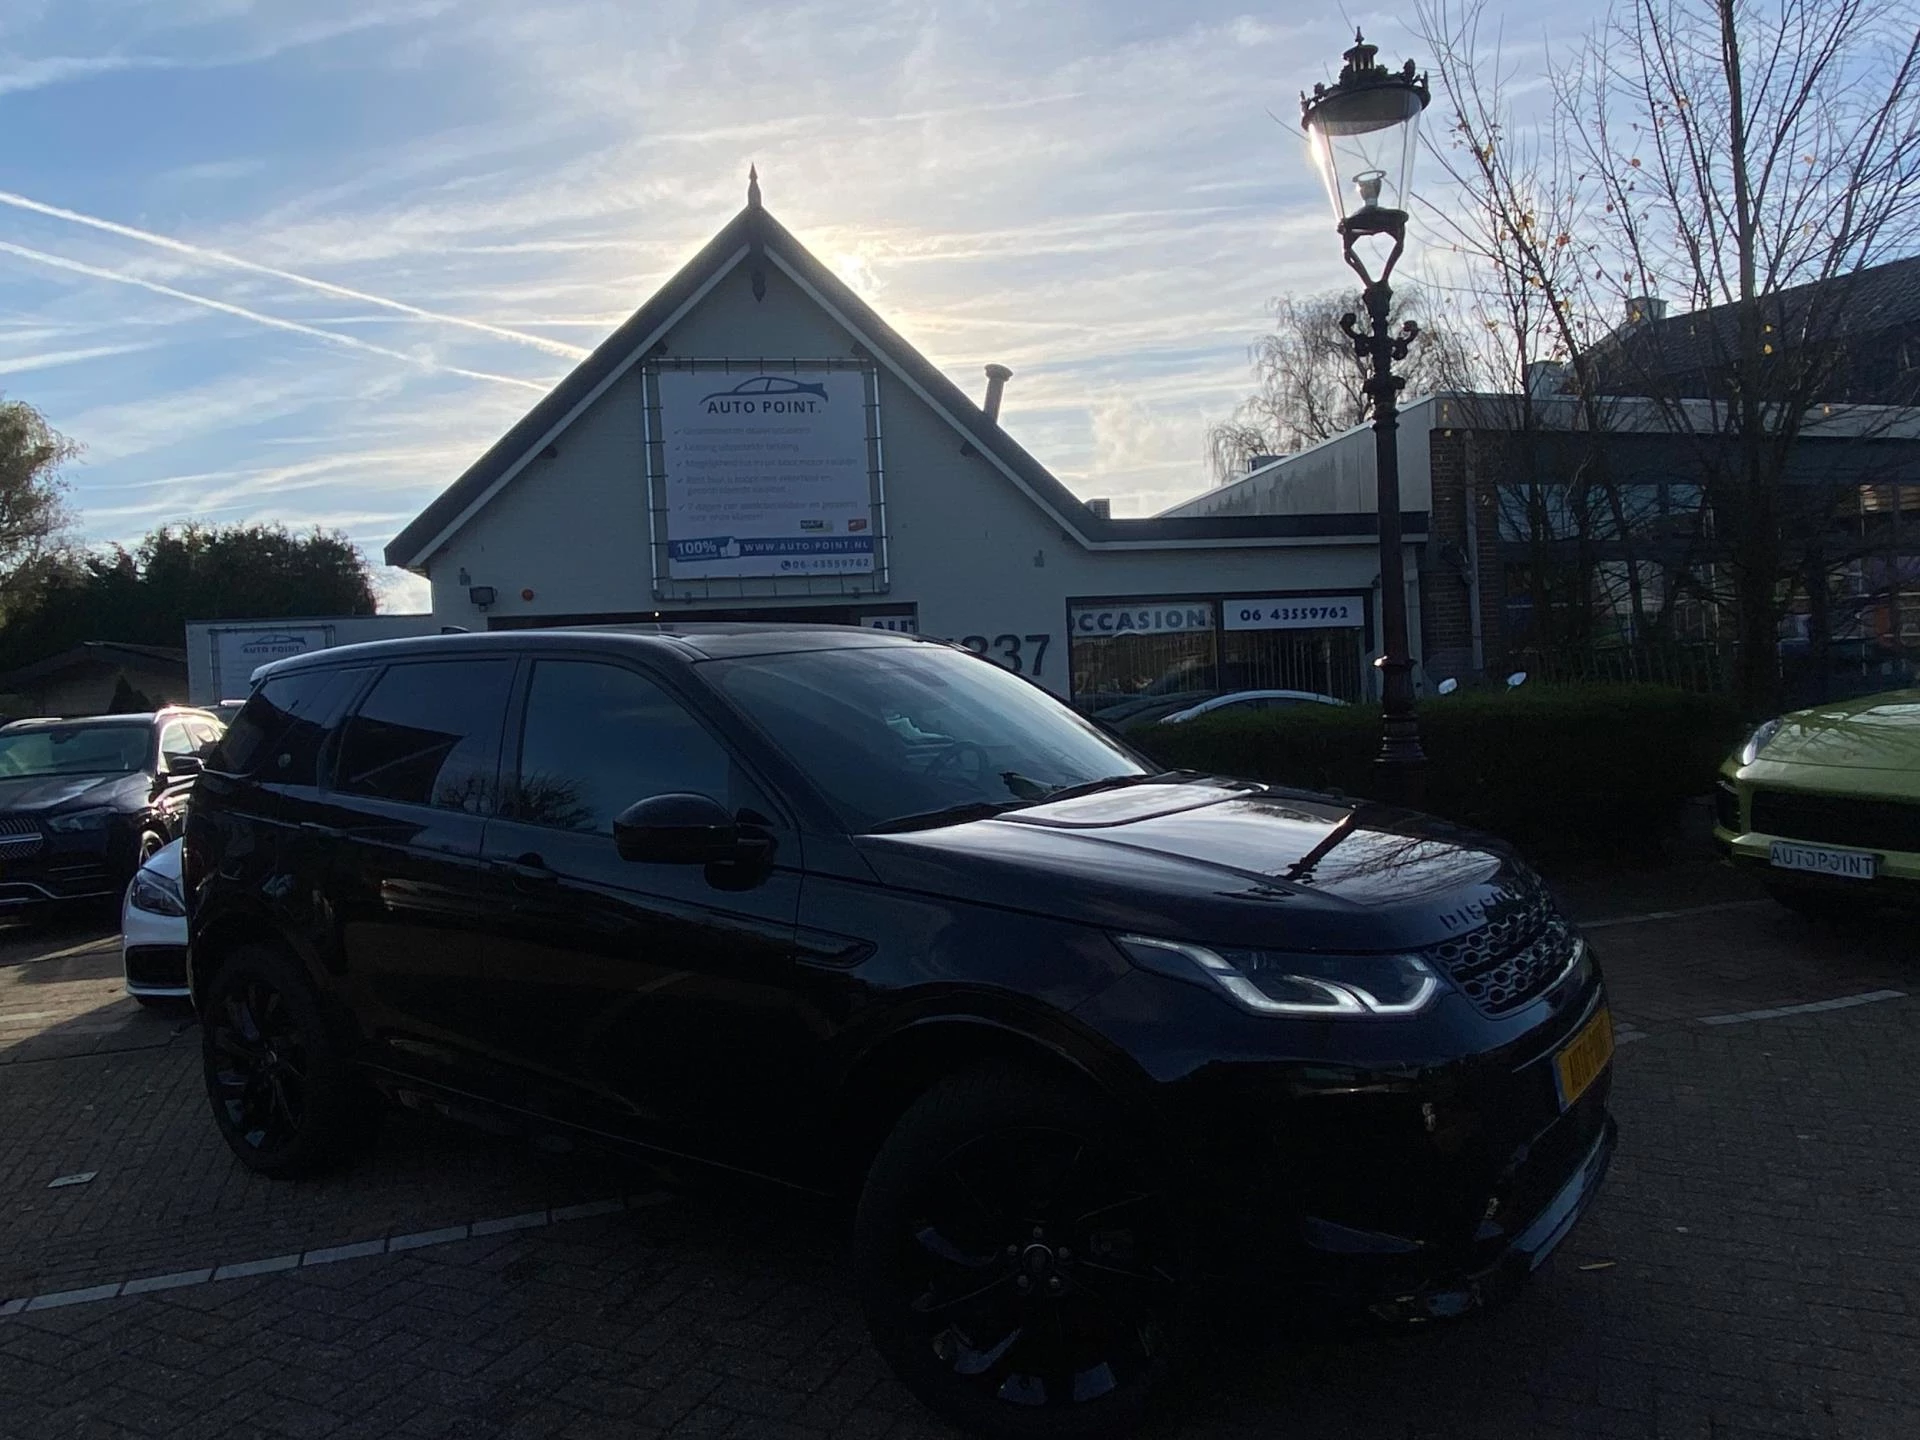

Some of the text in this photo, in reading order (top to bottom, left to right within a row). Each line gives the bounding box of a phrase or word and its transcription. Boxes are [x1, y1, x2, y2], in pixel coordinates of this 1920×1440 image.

[707, 400, 755, 414] AUTO
[677, 541, 717, 556] 100%
[1240, 606, 1349, 622] 06 43559762
[243, 646, 268, 654] AUTO
[1771, 846, 1873, 876] AUTOPOINT
